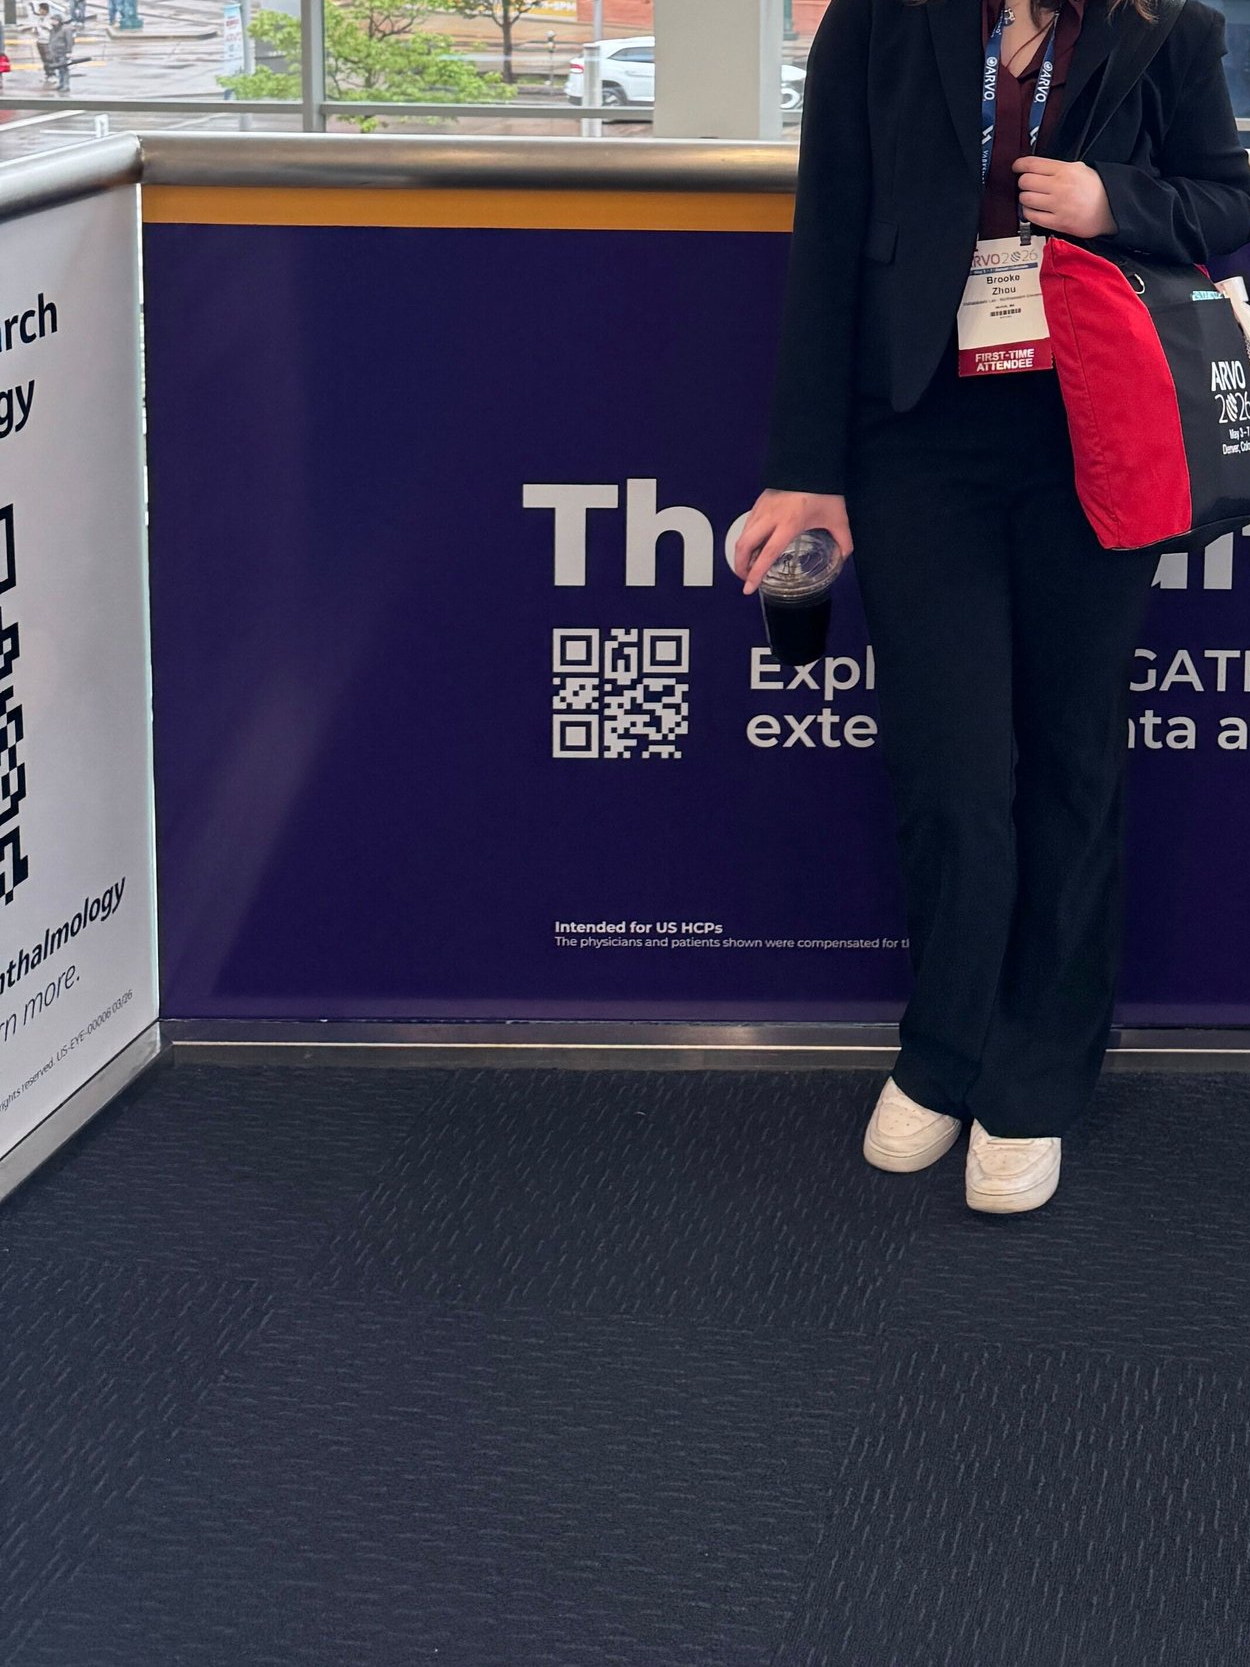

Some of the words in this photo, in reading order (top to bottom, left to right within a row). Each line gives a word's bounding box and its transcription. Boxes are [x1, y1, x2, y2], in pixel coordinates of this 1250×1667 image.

[972, 253, 1001, 268] RVO
[986, 274, 1020, 285] Brooke
[992, 286, 1016, 296] Zhou
[0, 293, 58, 353] rch
[975, 348, 1035, 363] FIRST-TIME
[976, 358, 1033, 372] ATTENDEE
[1211, 360, 1246, 392] ARVO
[555, 921, 626, 934] Intended
[629, 921, 652, 934] for
[656, 922, 677, 934] US
[681, 922, 723, 934] HCPs
[555, 936, 577, 947] The
[580, 936, 643, 949] physicians
[646, 937, 668, 947] and
[671, 937, 720, 949] patients
[722, 937, 763, 948] shown
[765, 939, 795, 948] were
[797, 938, 879, 950] compensated
[882, 938, 899, 948] for
[23, 964, 80, 1026] more.
[21, 1056, 56, 1091] reserved.
